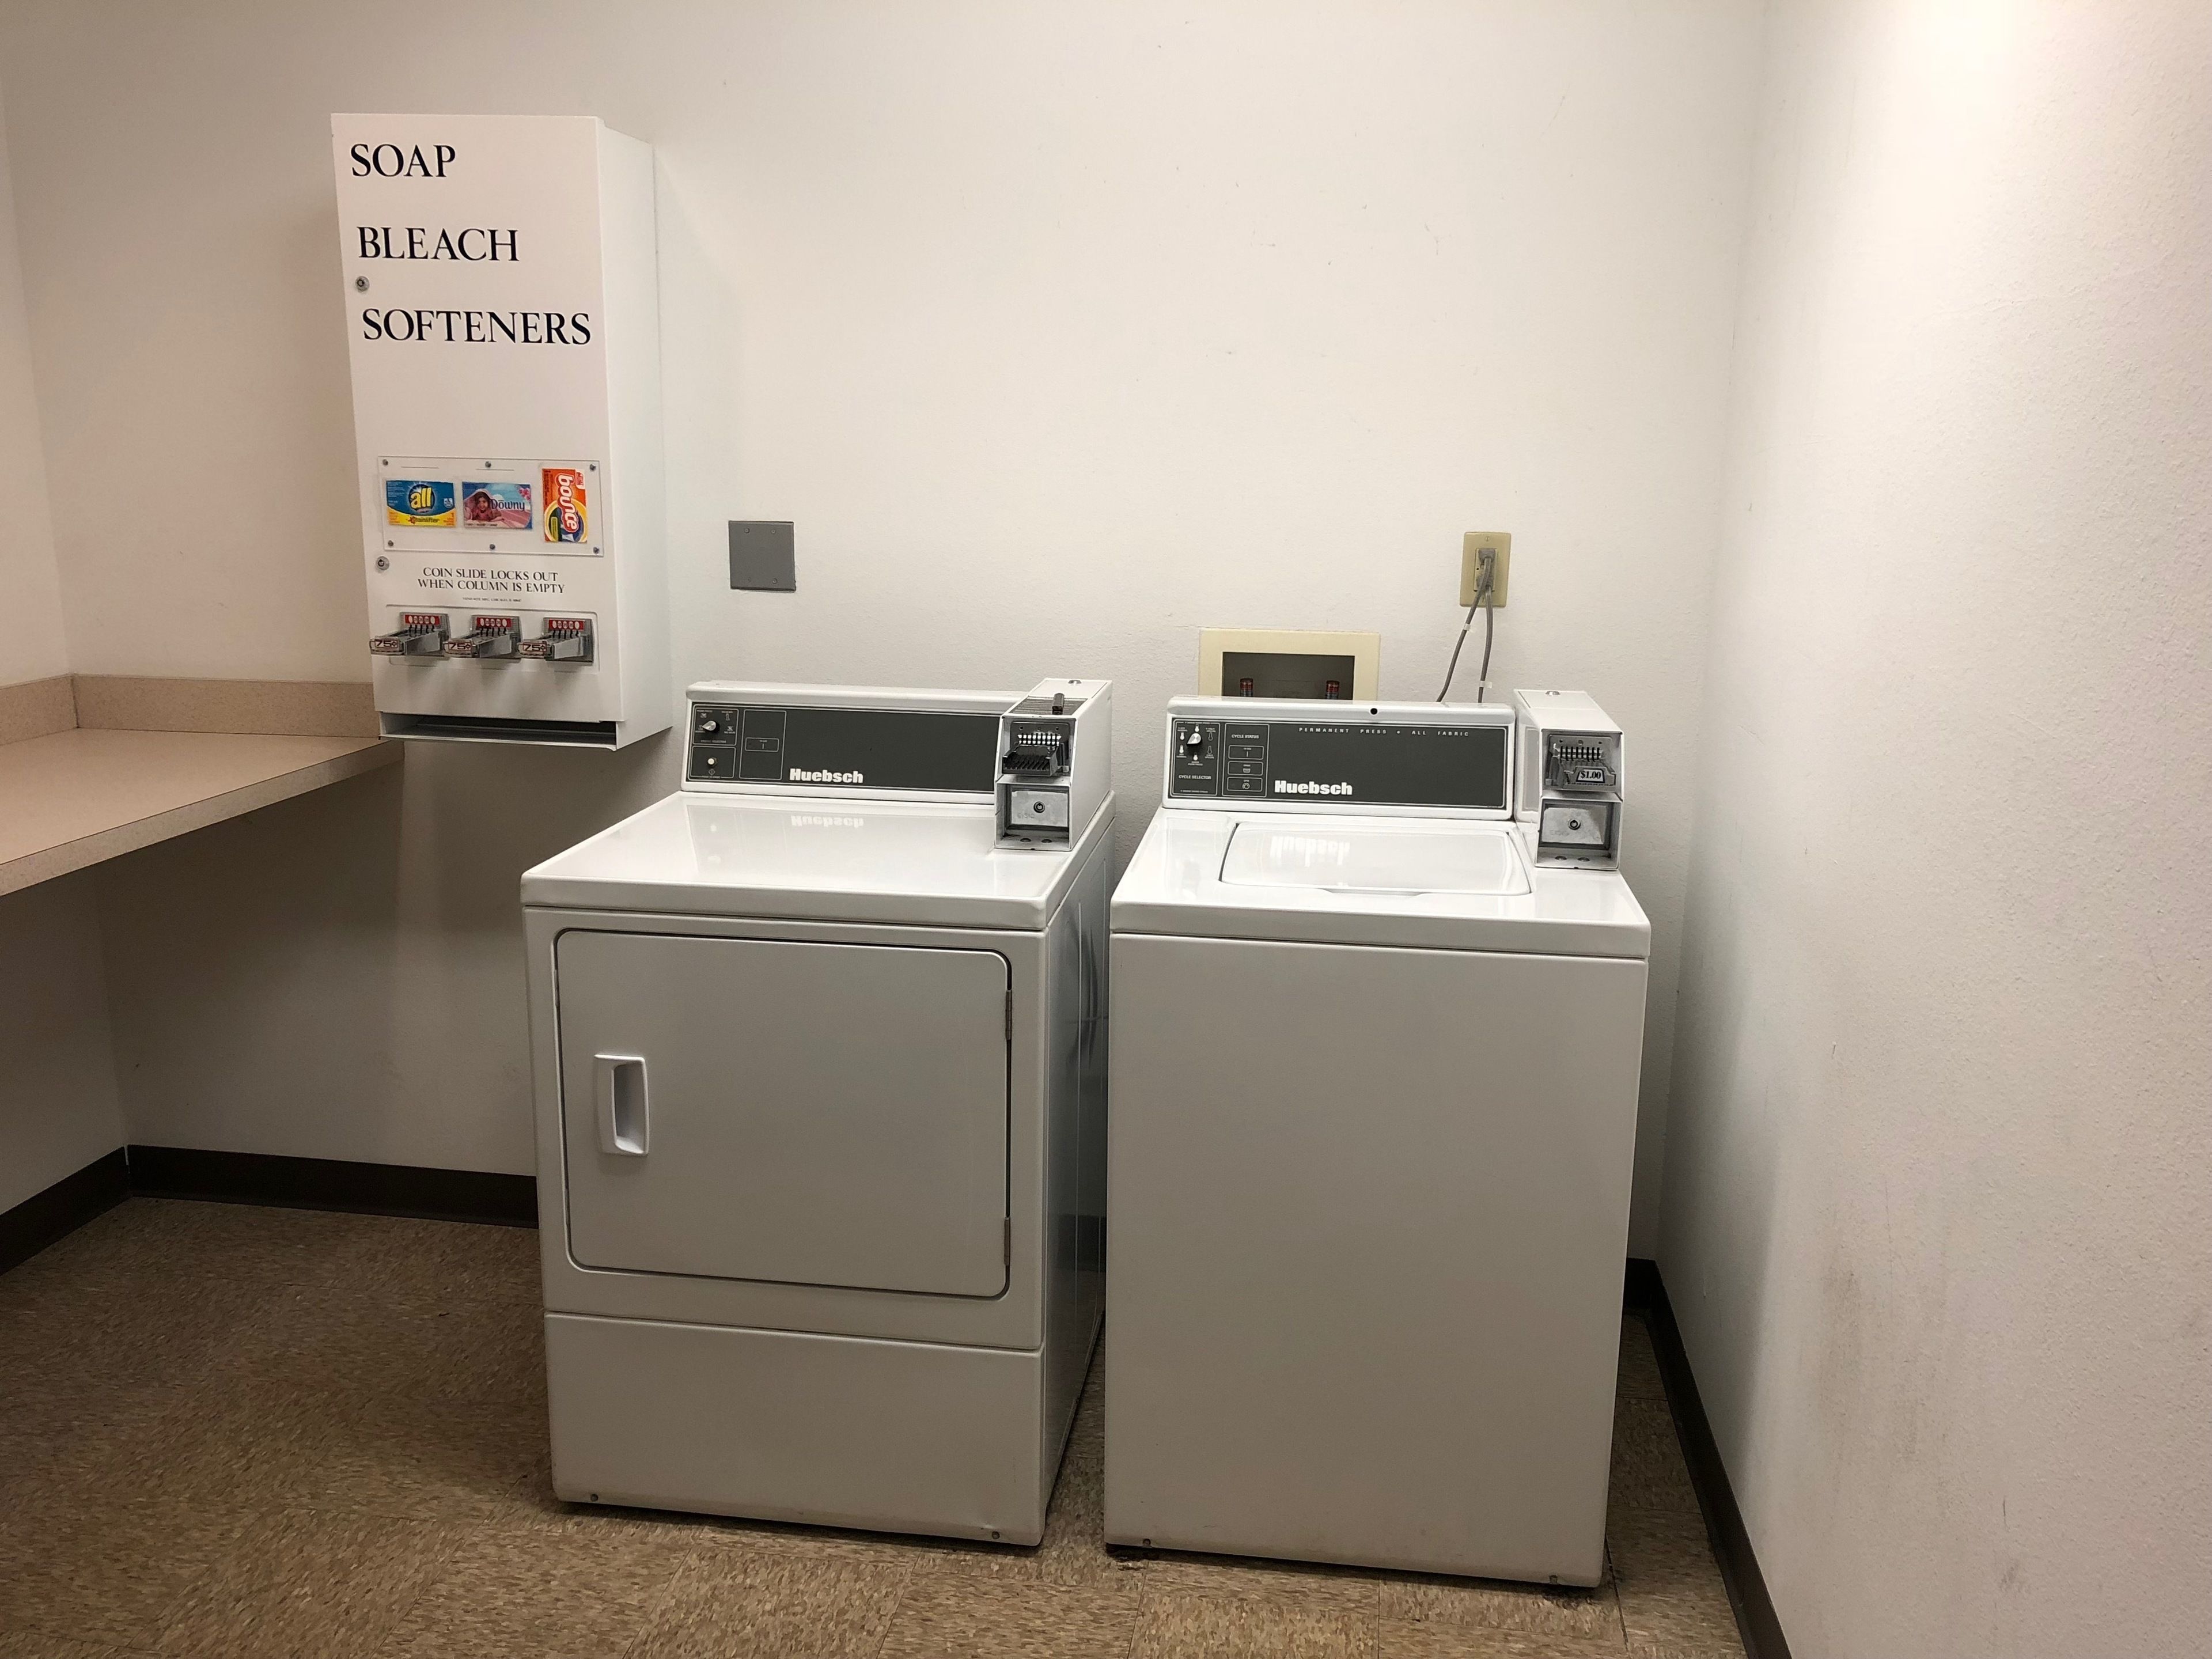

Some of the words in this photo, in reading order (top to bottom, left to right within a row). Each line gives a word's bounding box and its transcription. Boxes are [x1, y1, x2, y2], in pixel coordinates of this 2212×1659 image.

[351, 143, 456, 177] SOAP
[357, 226, 519, 262] BLEACH
[362, 308, 591, 345] SOFTENERS
[410, 487, 432, 509] all
[558, 474, 577, 530] bounce
[423, 567, 452, 577] COIN
[456, 569, 487, 579] SLIDE
[491, 570, 529, 581] LOCKS
[533, 571, 558, 582] OUT
[418, 578, 453, 589] WHEN
[457, 580, 508, 592] COLUMN
[512, 582, 522, 592] IS
[526, 583, 565, 594] EMPTY
[449, 642, 471, 650] 75¢
[525, 643, 546, 652] 75¢
[789, 768, 864, 785] Huebsch
[1580, 771, 1601, 779] $1.00
[1274, 780, 1353, 796] Huebsch
